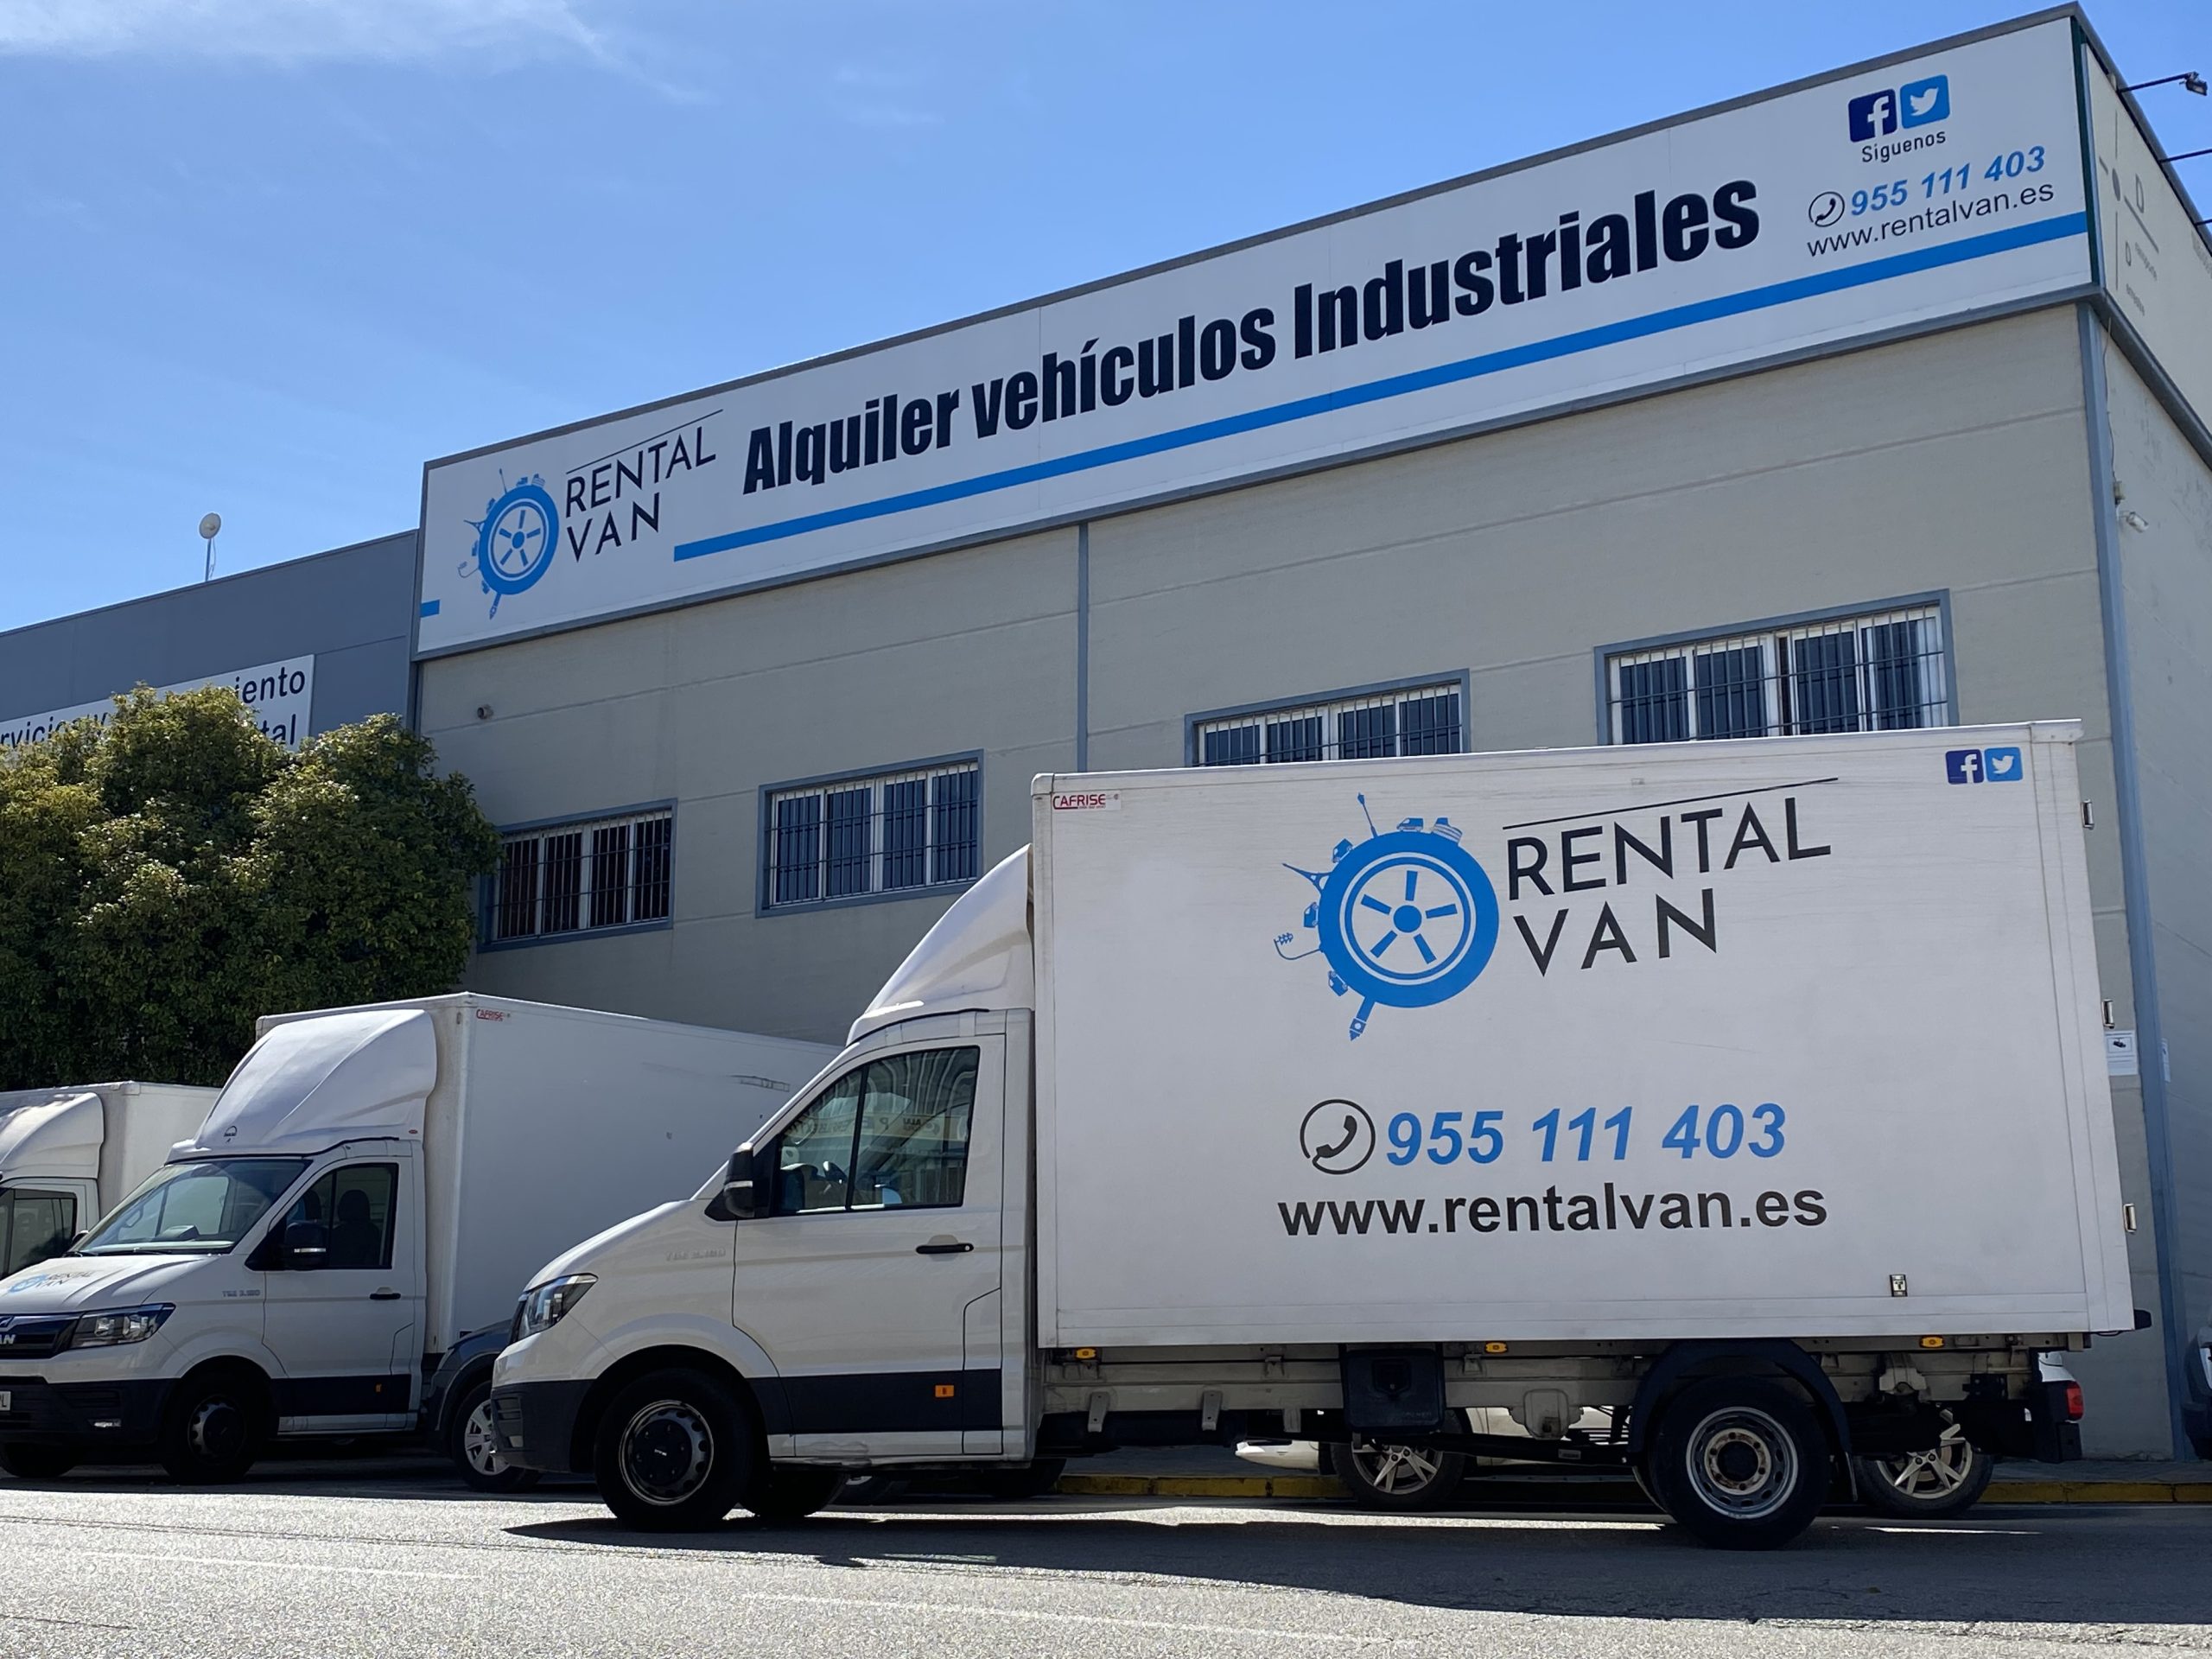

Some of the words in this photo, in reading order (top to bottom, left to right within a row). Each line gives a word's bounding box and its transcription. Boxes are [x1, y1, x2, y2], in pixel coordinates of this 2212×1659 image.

[1851, 179, 1909, 216] 955
[1921, 162, 1971, 199] 111
[1983, 145, 2046, 182] 403
[1807, 183, 2055, 257] www.rentalvan.es
[742, 388, 961, 495] Alquiler
[971, 307, 1277, 439] vehículos
[1294, 179, 1760, 360] Industriales
[565, 425, 717, 518] RENTAL
[566, 491, 661, 563] VAN
[234, 666, 306, 704] iento
[260, 713, 297, 746] tal
[1052, 793, 1107, 810] CAFRISE
[1507, 794, 1833, 901] RENTAL
[1513, 887, 1718, 977] VAN
[1386, 1110, 1504, 1166] 955
[1532, 1106, 1633, 1162] 111
[1661, 1103, 1787, 1160] 403
[1277, 1181, 1827, 1236] www.rentalvan.es
